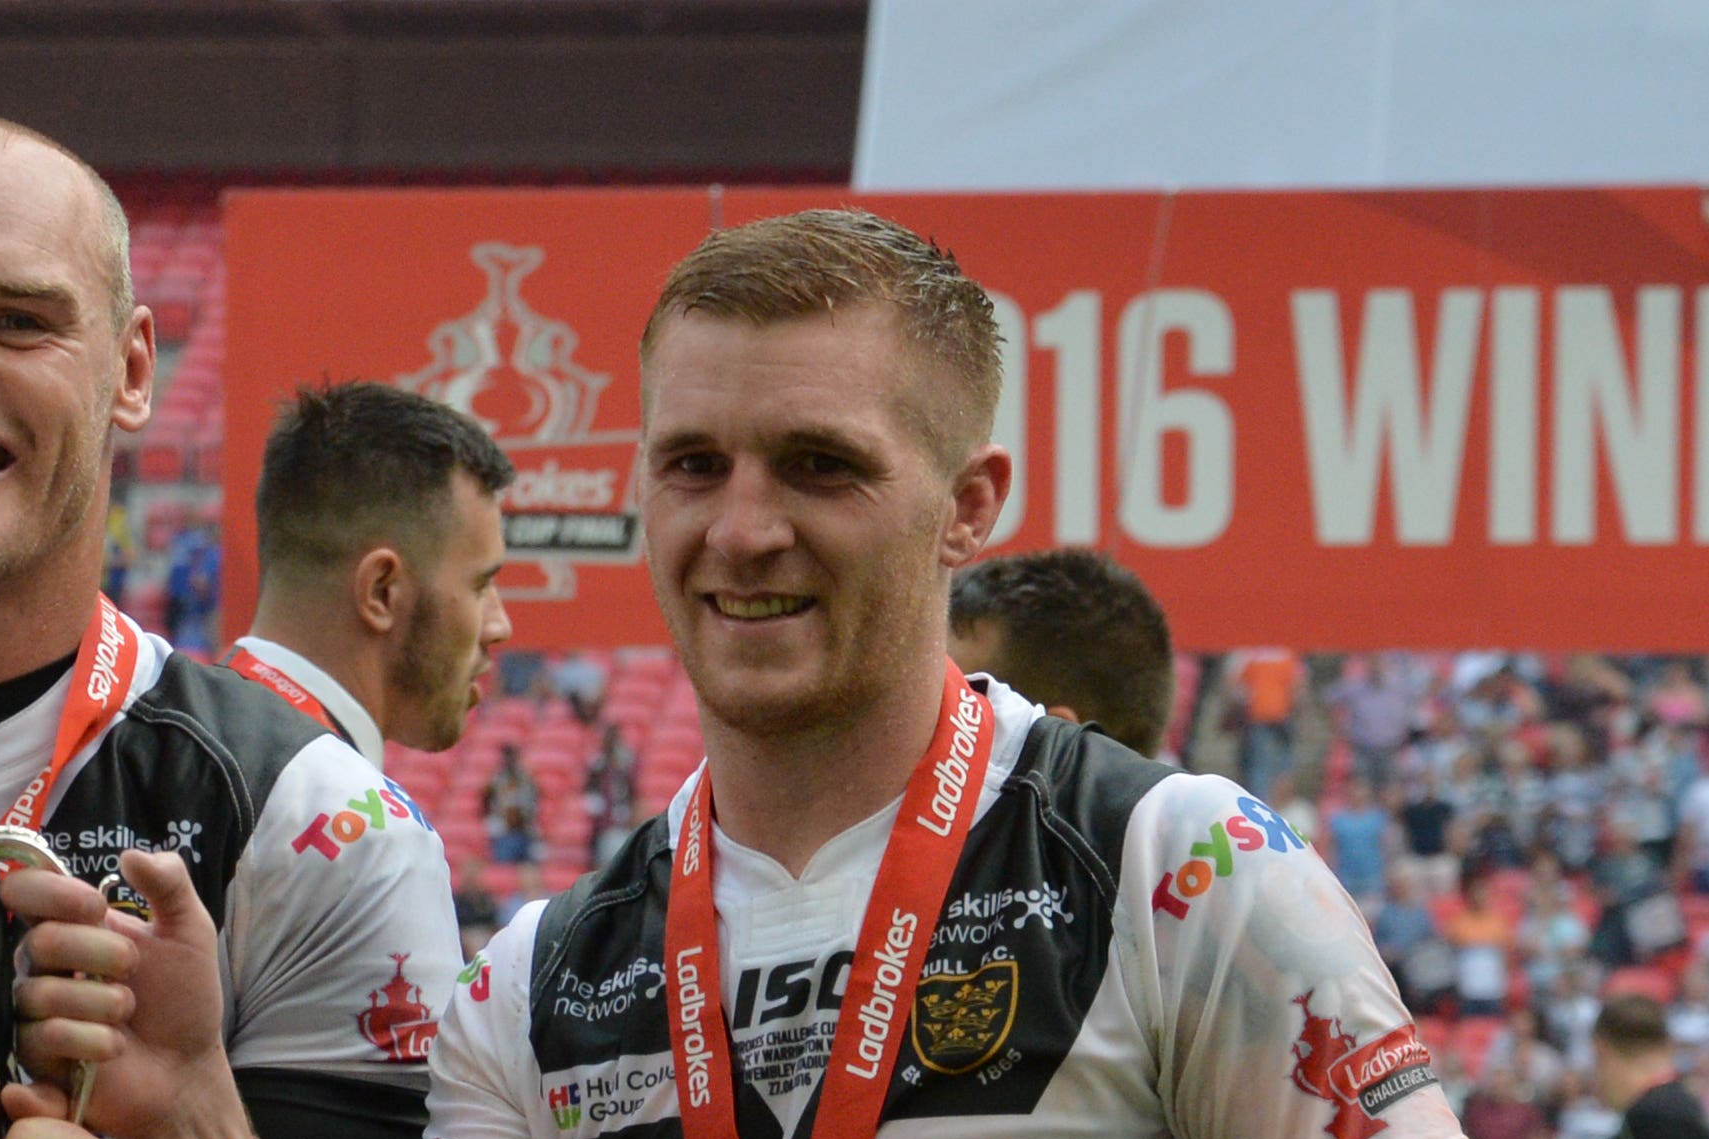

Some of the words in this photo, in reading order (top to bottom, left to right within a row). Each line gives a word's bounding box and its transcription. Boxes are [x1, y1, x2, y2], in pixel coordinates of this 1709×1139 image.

[1291, 285, 1709, 547] WIN
[916, 688, 984, 838] Ladbrokes
[845, 908, 919, 1080] Ladbrokes
[932, 914, 1005, 949] etwork
[676, 946, 714, 1109] Ladbrokes
